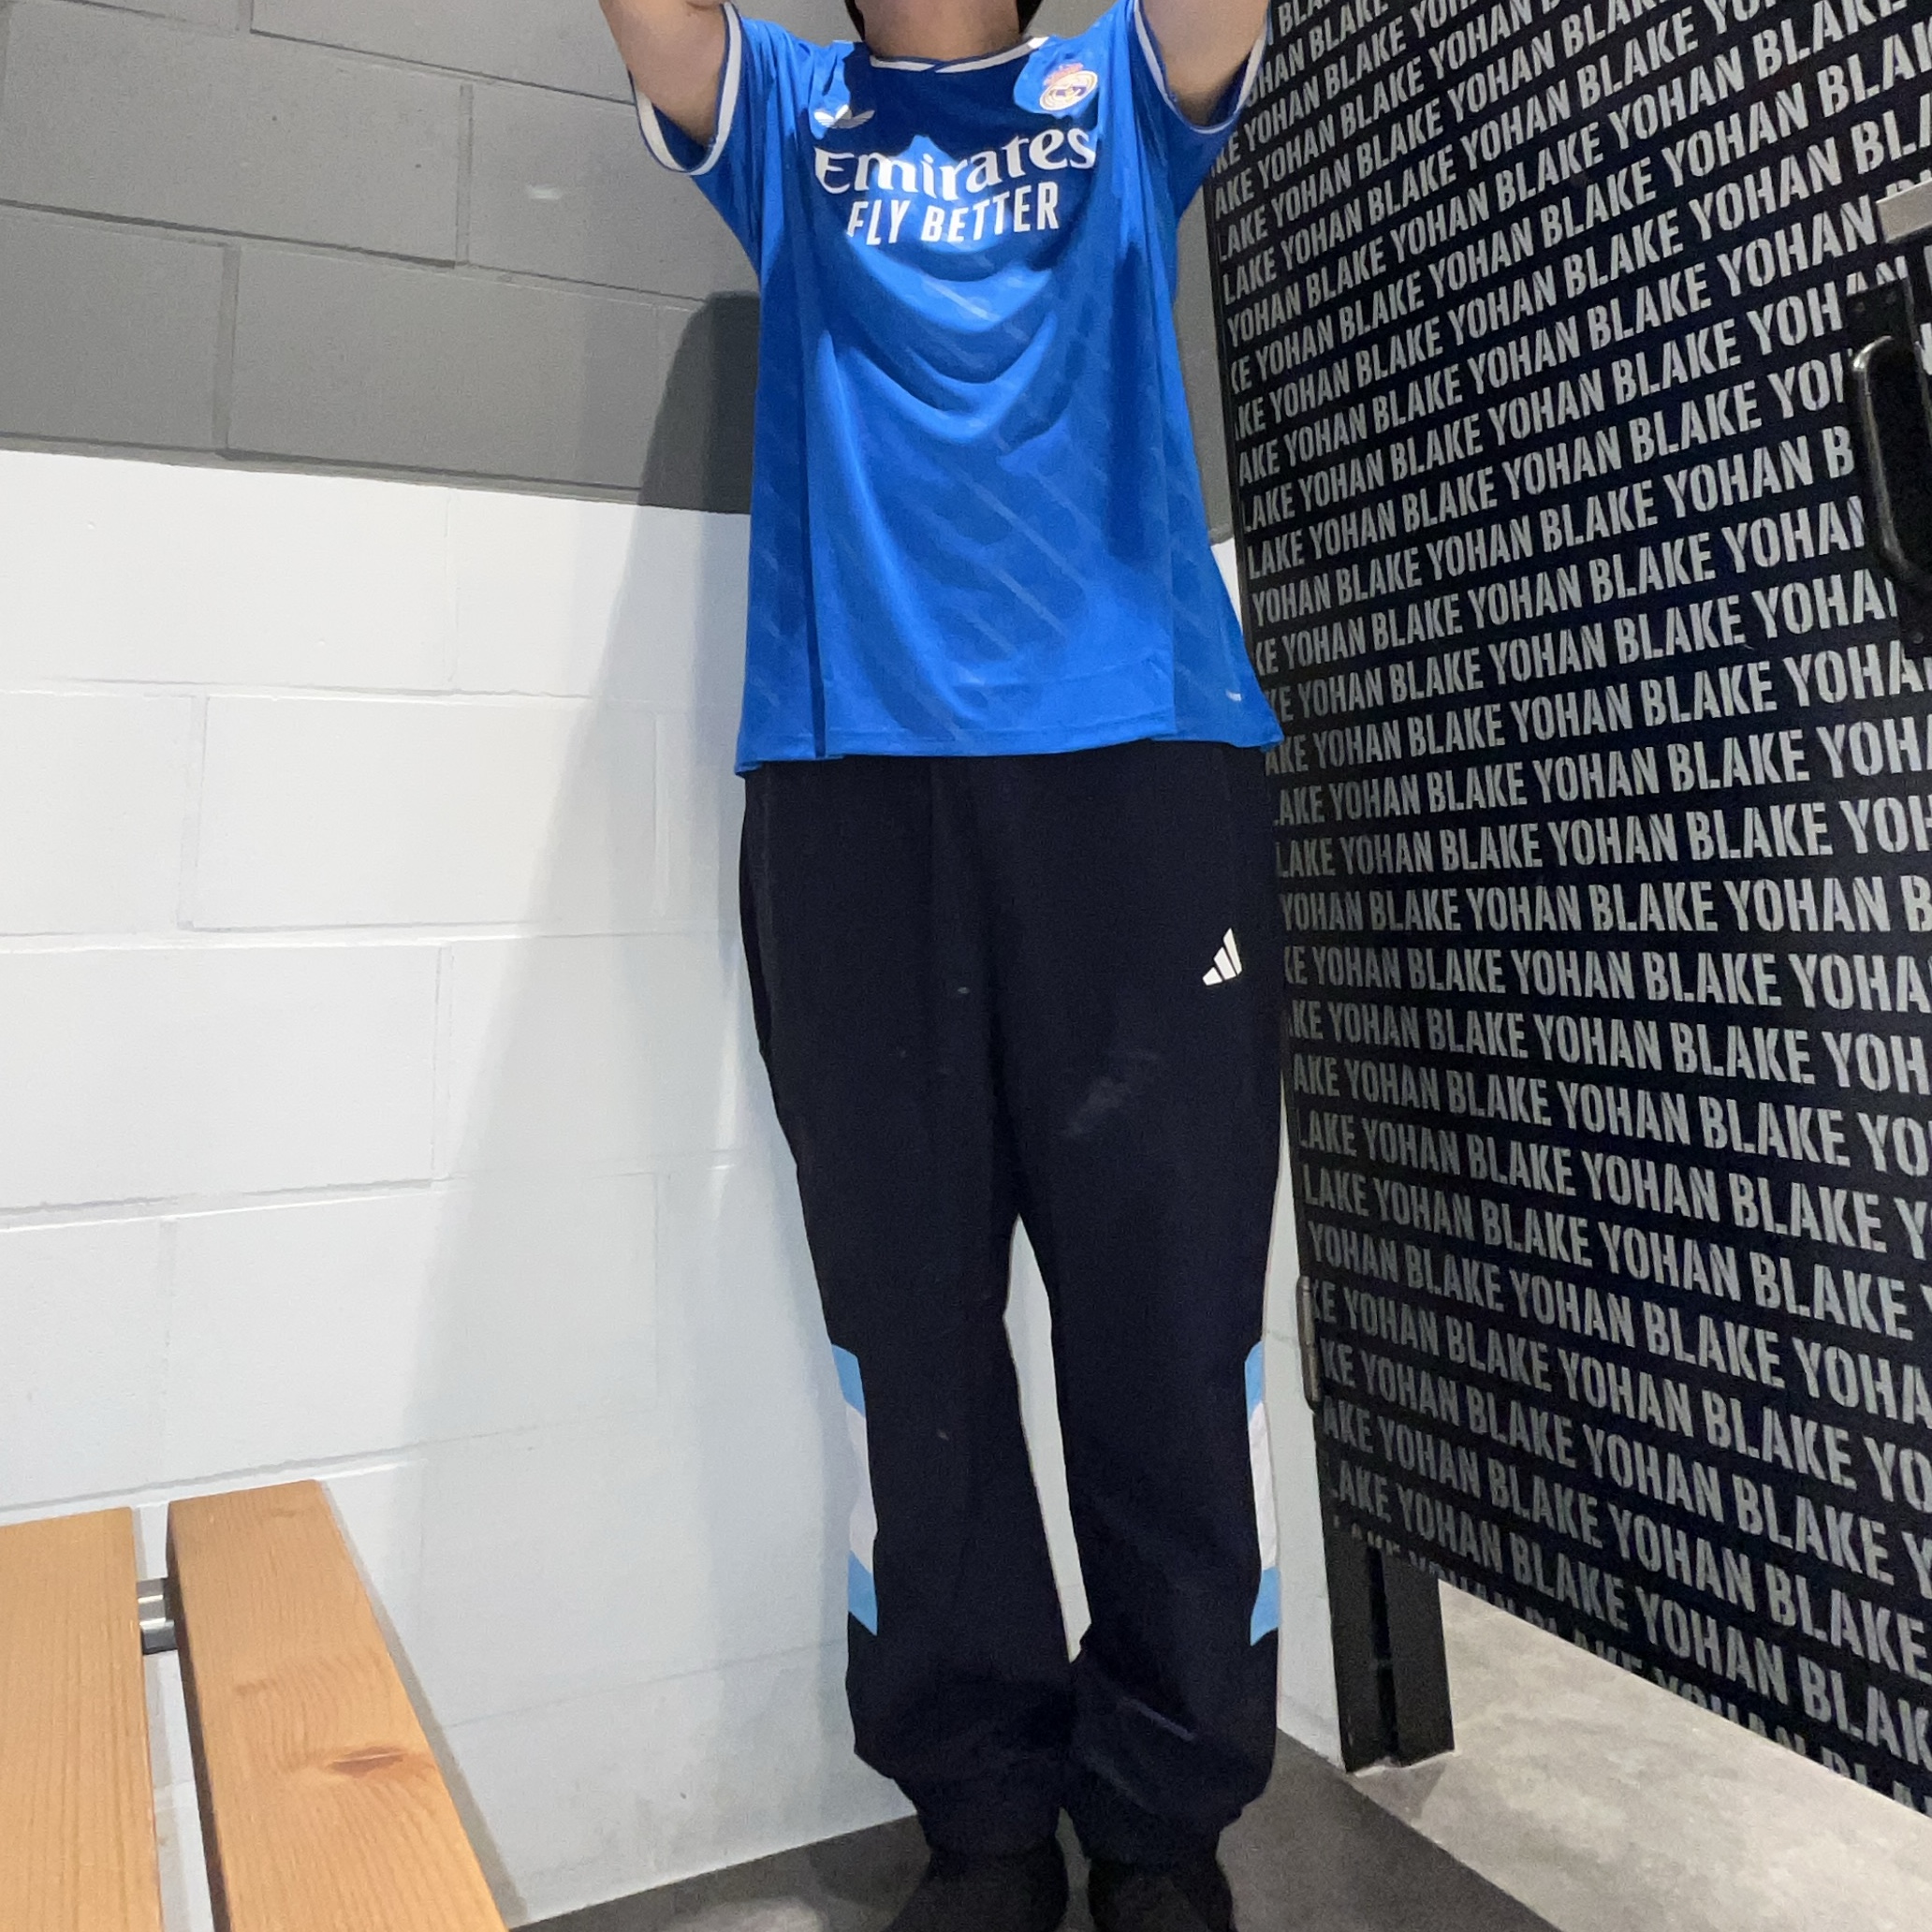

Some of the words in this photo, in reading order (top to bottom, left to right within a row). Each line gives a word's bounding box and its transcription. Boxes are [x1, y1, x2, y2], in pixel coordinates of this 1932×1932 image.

[813, 127, 1097, 203] Emirates
[1222, 246, 1277, 306] LAKE
[1280, 198, 1363, 271] YOHAN
[1367, 143, 1456, 226] BLAKE
[1459, 79, 1571, 171] YOHAN
[1576, 6, 1699, 110] BLAKE
[1243, 75, 1321, 152] YOHAN
[1324, 15, 1407, 100] BLAKE
[1257, 113, 1336, 190] YOHAN
[1339, 55, 1425, 139] BLAKE
[1428, 0, 1533, 80] YOHAN
[1270, 153, 1352, 228] YOHAN
[1356, 97, 1443, 180] BLAKE
[1446, 29, 1556, 123] YOHAN
[846, 198, 911, 246] FLY
[920, 182, 1060, 243] BETTER
[1227, 282, 1302, 348] YOHAN
[1305, 236, 1386, 309] BLAKE
[1389, 181, 1490, 264] YOHAN
[1495, 122, 1603, 212] BLAKE
[1607, 46, 1745, 150] YOHAN
[1255, 315, 1334, 381] YOHAN
[1339, 271, 1425, 344] BLAKE
[1427, 216, 1534, 300] YOHAN
[1540, 156, 1657, 249] BLAKE
[1661, 81, 1809, 188] YOHAN
[1268, 358, 1351, 424] YOHAN
[1354, 315, 1443, 388] BLAKE
[1447, 265, 1557, 346] YOHAN
[1562, 208, 1684, 299] BLAKE
[1688, 137, 1842, 242] YOHAN
[1239, 438, 1281, 487] AKE
[1283, 402, 1368, 467] YOHAN
[1371, 363, 1463, 434] BLAKE
[1467, 315, 1581, 395] YOHAN
[1587, 262, 1712, 351] BLAKE
[1716, 194, 1878, 298] YOHAN
[1297, 448, 1384, 512] YOHAN
[1390, 413, 1484, 482] BLAKE
[1487, 368, 1605, 446] YOHAN
[1611, 318, 1741, 405] BLAKE
[1248, 529, 1305, 579] LAKE
[1309, 499, 1397, 560] YOHAN
[1401, 465, 1498, 533] BLAKE
[1501, 425, 1622, 501] YOHAN
[1628, 379, 1763, 464] BLAKE
[1252, 573, 1332, 627] YOHAN
[1335, 547, 1423, 607] BLAKE
[1426, 515, 1533, 581] YOHAN
[1539, 479, 1659, 553] BLAKE
[1662, 435, 1814, 519] YOHAN
[1281, 616, 1367, 670] YOHAN
[1370, 593, 1463, 651] BLAKE
[1467, 564, 1583, 629] YOHAN
[1588, 532, 1716, 604] BLAKE
[1297, 667, 1384, 719] YOHAN
[1388, 647, 1484, 704] BLAKE
[1487, 622, 1607, 685] YOHAN
[1614, 594, 1746, 665] BLAKE
[1750, 568, 1898, 639] YOHA
[1273, 785, 1325, 827] AKE
[1328, 773, 1421, 822] YOHAN
[1426, 761, 1528, 812] BLAKE
[1531, 746, 1660, 804] YOHAN
[1666, 728, 1810, 792] BLAKE
[1815, 713, 1932, 779] YOH
[1311, 719, 1402, 769] YOHAN
[1407, 703, 1506, 757] BLAKE
[1509, 682, 1633, 743] YOHAN
[1640, 660, 1778, 727] BLAKE
[1782, 636, 1932, 708] YOHA
[1280, 890, 1364, 931] YOHAN
[1368, 887, 1461, 931] BLAKE
[1465, 885, 1582, 931] YOHAN
[1588, 881, 1719, 931] BLAKE
[1722, 876, 1891, 932] YOHAN
[1339, 830, 1434, 875] YOHAN
[1439, 823, 1544, 871] BLAKE
[1547, 812, 1678, 867] YOHAN
[1686, 802, 1834, 861] BLAKE
[1311, 945, 1402, 989] YOHAN
[1407, 947, 1506, 994] BLAKE
[1510, 949, 1635, 1000] YOHAN
[1642, 951, 1782, 1006] BLAKE
[1788, 953, 1932, 1014] YOHA
[1327, 1002, 1421, 1049] YOHAN
[1426, 1007, 1529, 1059] BLAKE
[1532, 1014, 1662, 1071] YOHAN
[1669, 1022, 1816, 1085] BLAKE
[1821, 1031, 1931, 1095] YOH
[1294, 1053, 1340, 1097] AKE
[1343, 1058, 1441, 1111] YOHAN
[1445, 1069, 1552, 1127] BLAKE
[1557, 1080, 1690, 1146] YOHAN
[1698, 1095, 1851, 1167] BLAKE
[1361, 1118, 1461, 1176] YOHAN
[1466, 1134, 1576, 1196] BLAKE
[1581, 1150, 1720, 1222] YOHAN
[1728, 1172, 1888, 1253] BLAKE
[1303, 1164, 1369, 1217] LAKE
[1372, 1177, 1475, 1241] YOHAN
[1480, 1198, 1593, 1267] BLAKE
[1597, 1222, 1741, 1302] YOHAN
[1749, 1251, 1913, 1341] BLAKE
[1308, 1220, 1399, 1283] YOHAN
[1404, 1243, 1504, 1312] BLAKE
[1508, 1269, 1635, 1348] YOHAN
[1643, 1300, 1785, 1389] BLAKE
[1342, 1286, 1440, 1356] YOHAN
[1445, 1315, 1552, 1393] BLAKE
[1557, 1348, 1694, 1438] YOHAN
[1701, 1389, 1857, 1491] BLAKE
[1360, 1350, 1460, 1427] YOHAN
[1466, 1385, 1576, 1469] BLAKE
[1582, 1423, 1724, 1523] YOHAN
[1732, 1473, 1895, 1586] BLAKE
[1377, 1413, 1481, 1499] YOHAN
[1487, 1457, 1603, 1549] BLAKE
[1607, 1502, 1756, 1613] YOHAN
[1764, 1562, 1932, 1686] BLAKE
[1398, 1483, 1503, 1574] YOHAN
[1509, 1531, 1629, 1632] BLAKE
[1634, 1586, 1789, 1705] YOHAN
